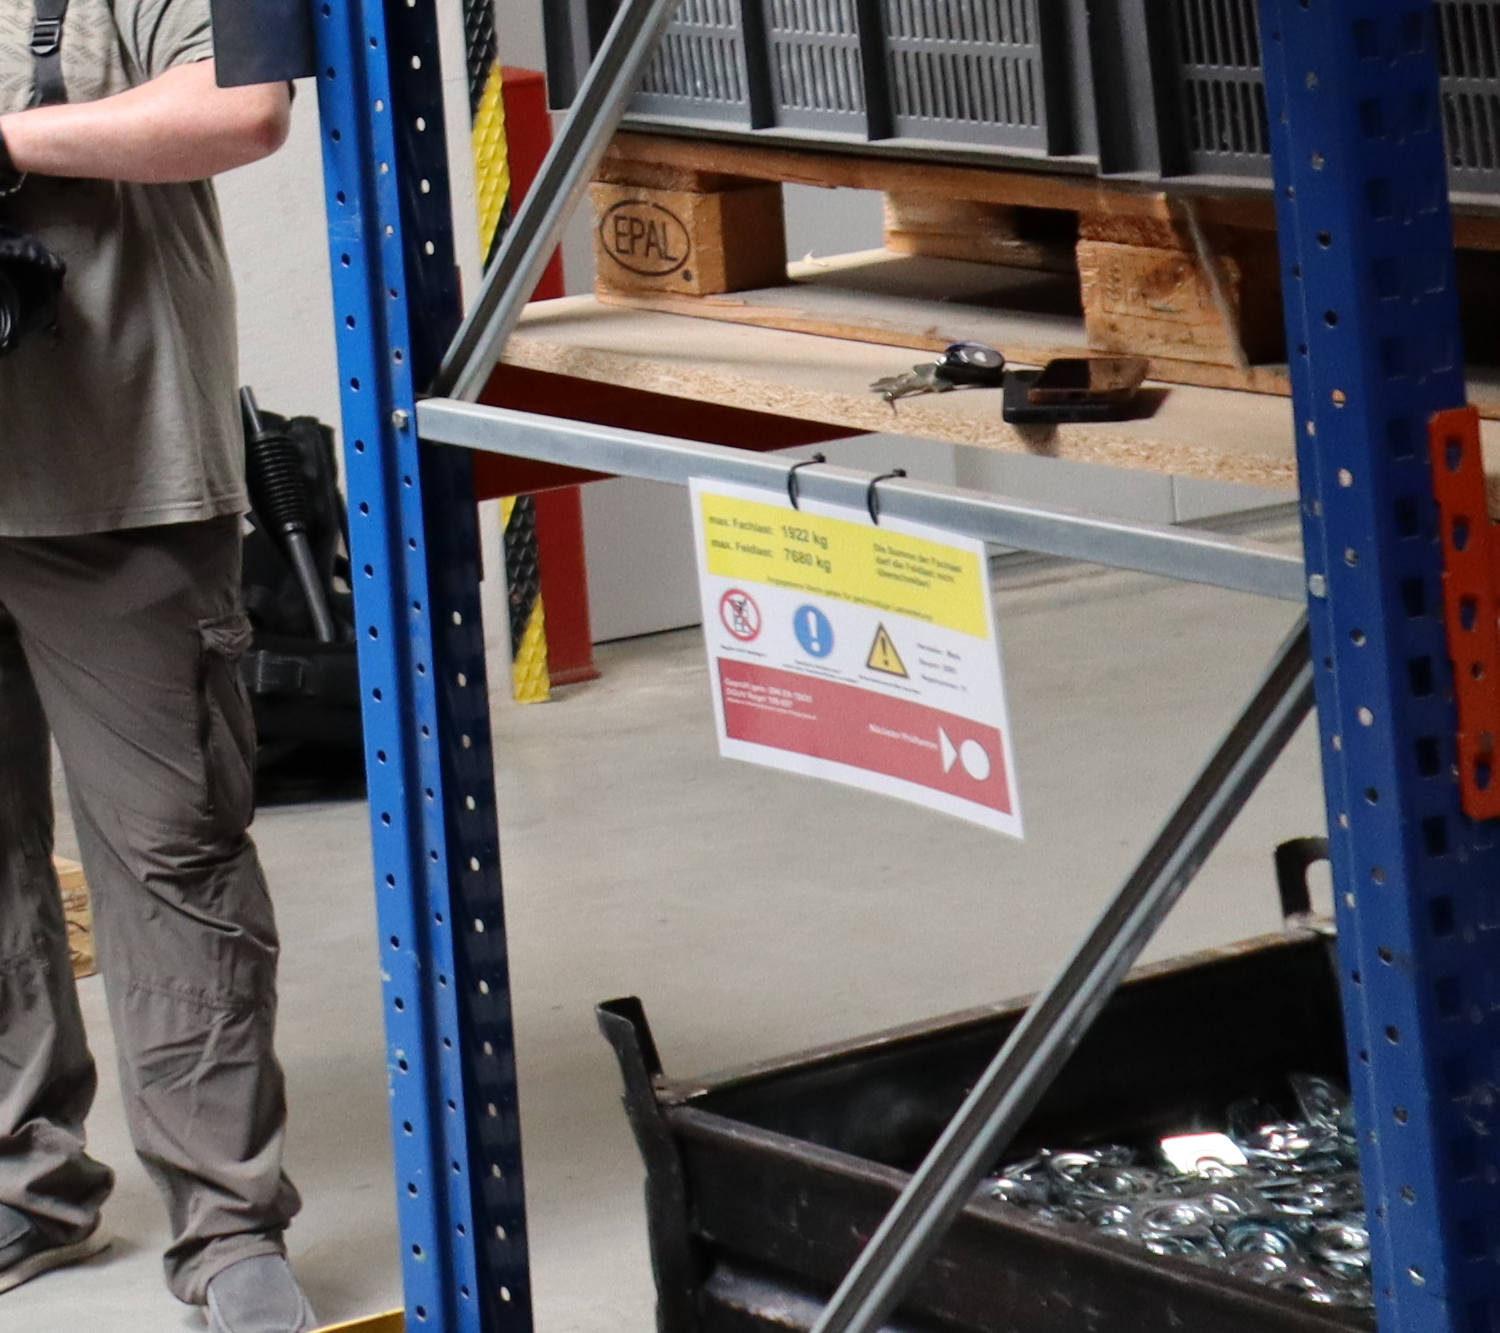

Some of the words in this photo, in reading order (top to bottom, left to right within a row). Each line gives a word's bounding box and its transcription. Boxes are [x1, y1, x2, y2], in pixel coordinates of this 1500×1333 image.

[613, 214, 678, 262] EPAL
[781, 525, 809, 543] 1922
[813, 532, 829, 550] kg
[784, 548, 813, 566] 7680
[816, 556, 832, 574] kg
